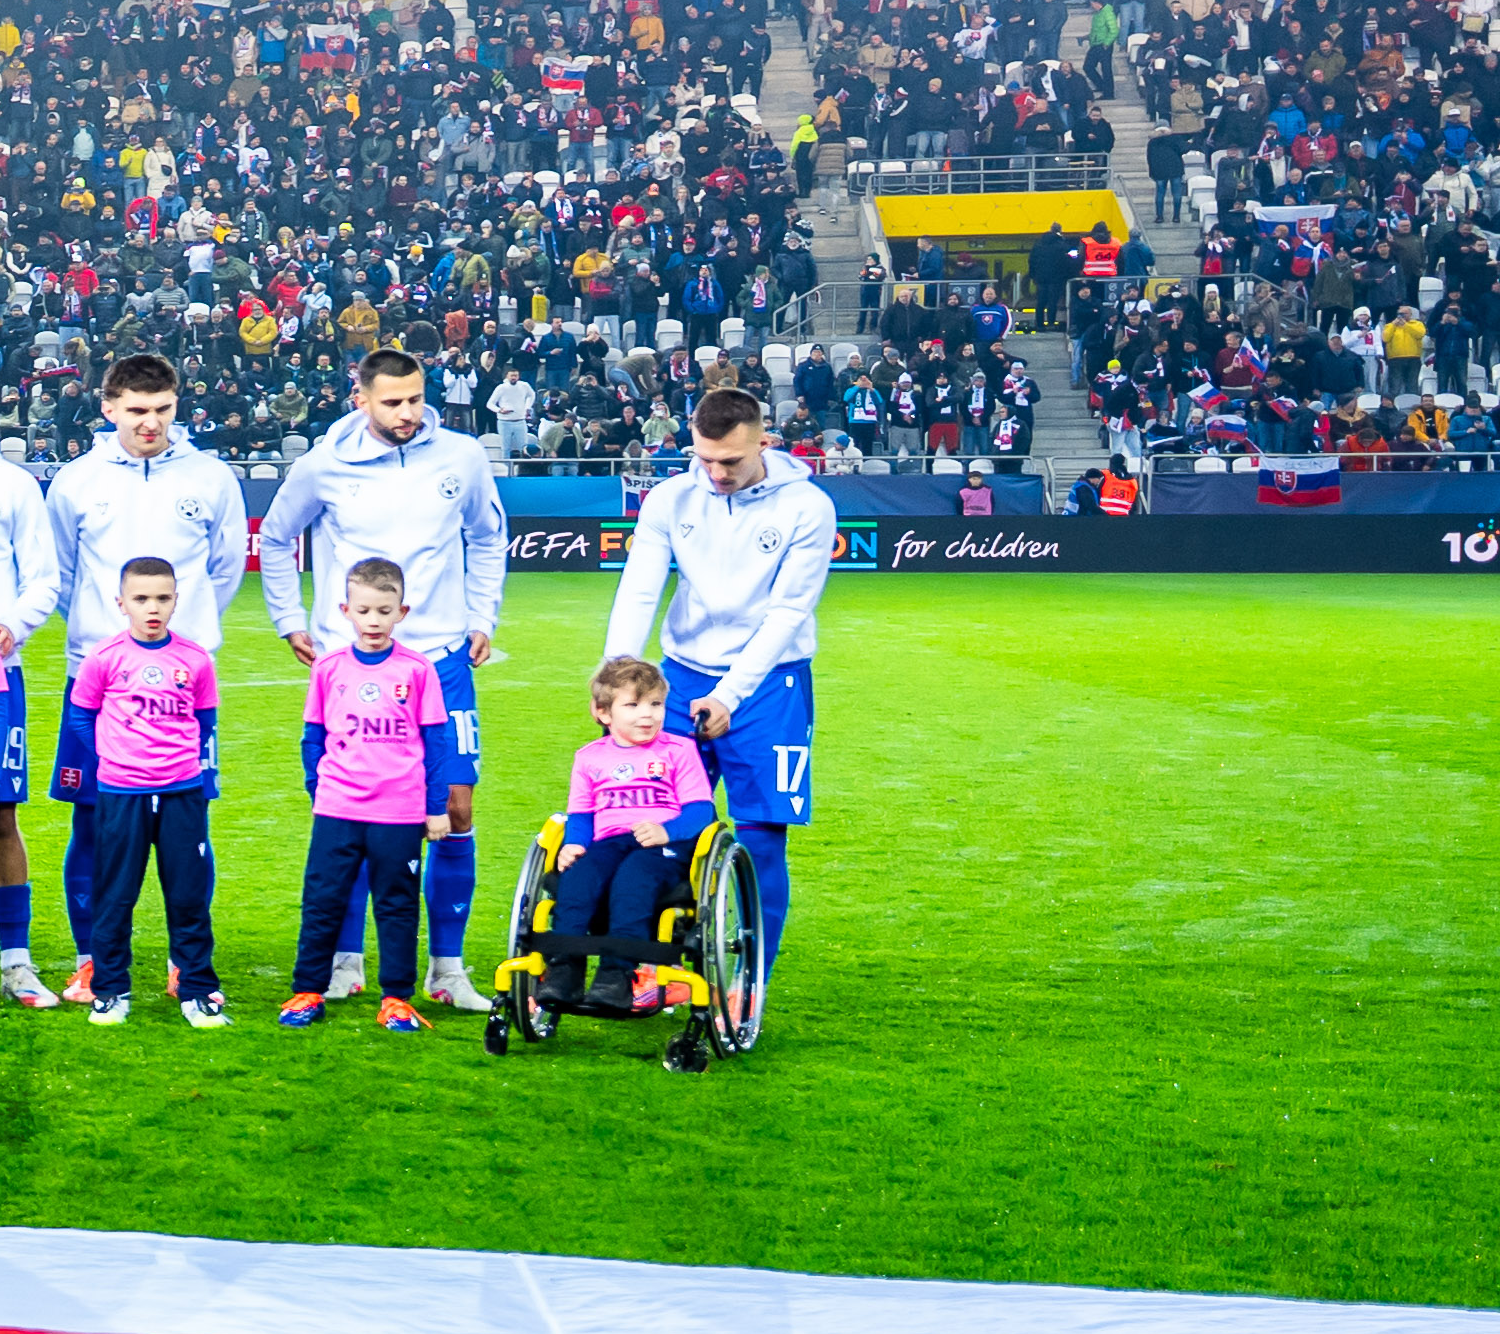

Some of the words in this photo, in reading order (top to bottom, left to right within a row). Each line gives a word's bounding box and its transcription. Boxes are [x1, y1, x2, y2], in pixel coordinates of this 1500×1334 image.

[891, 530, 937, 568] for
[944, 531, 1059, 559] children
[772, 745, 809, 793] 17
